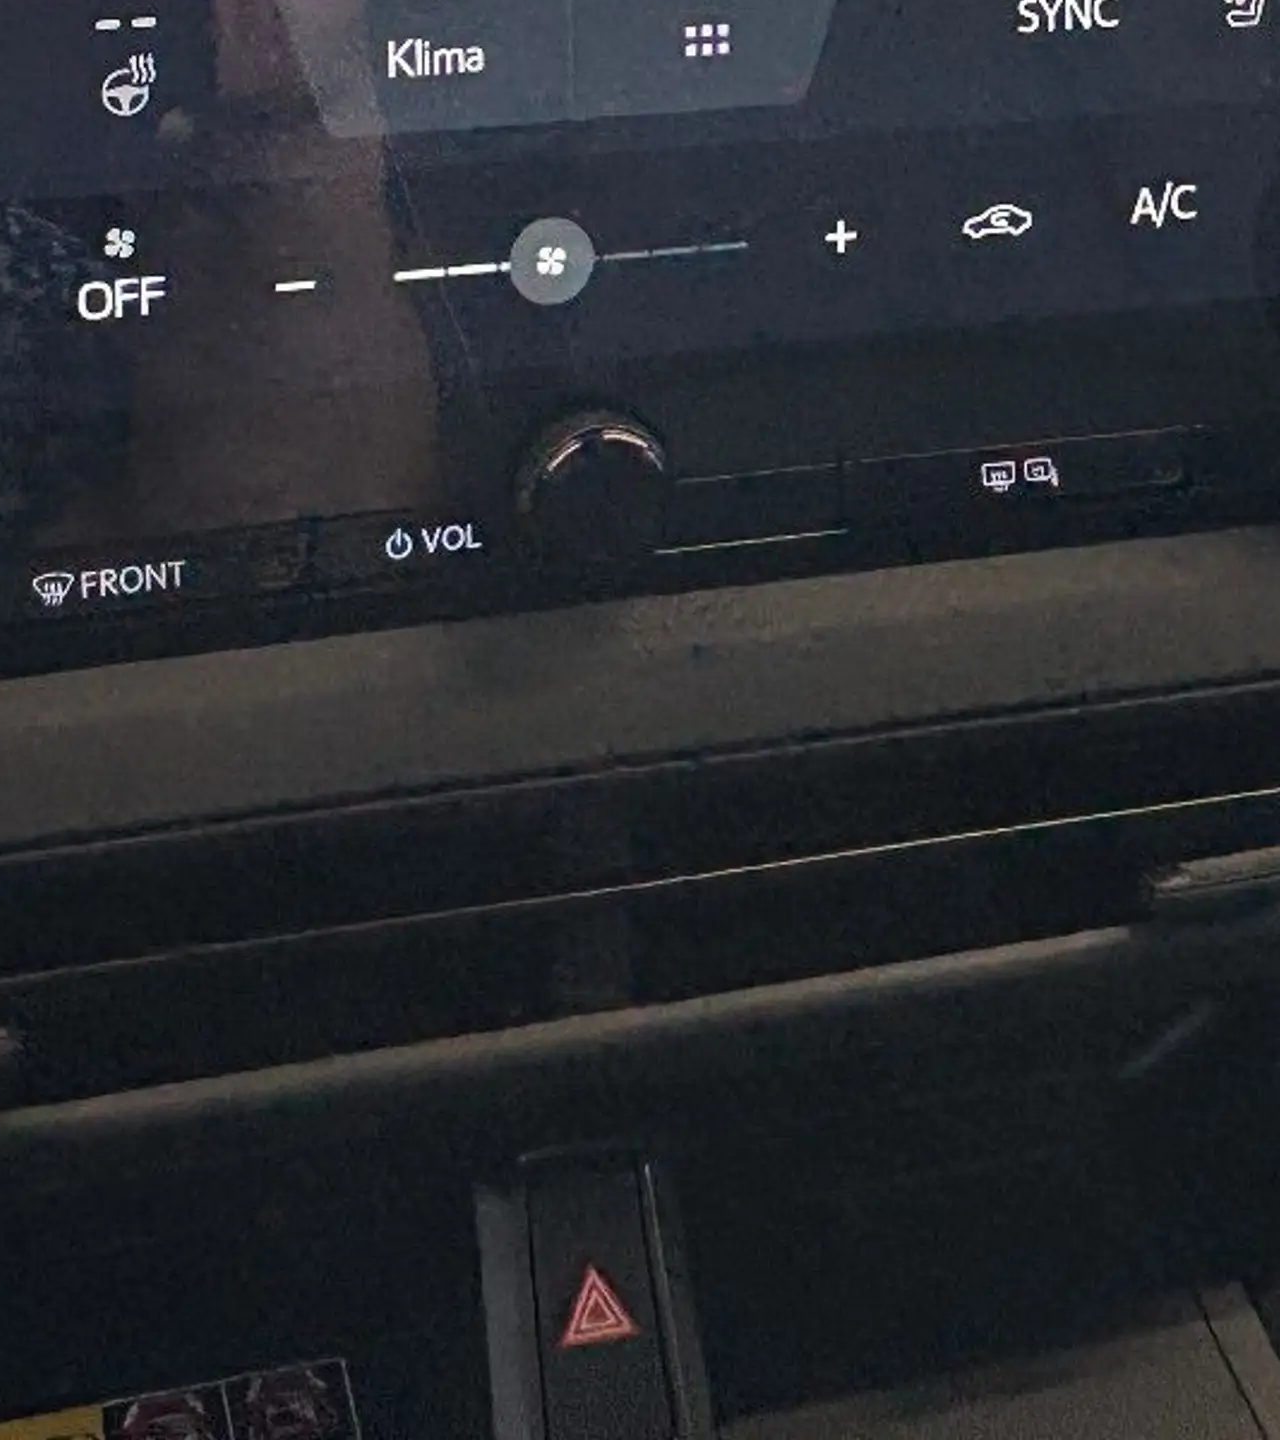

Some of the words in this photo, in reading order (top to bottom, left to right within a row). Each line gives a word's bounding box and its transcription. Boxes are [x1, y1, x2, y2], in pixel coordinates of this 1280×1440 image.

[386, 39, 485, 78] Klima
[1131, 182, 1198, 229] A/C
[77, 276, 168, 321] OFF
[421, 522, 484, 554] VOL
[80, 560, 187, 600] FRONT
